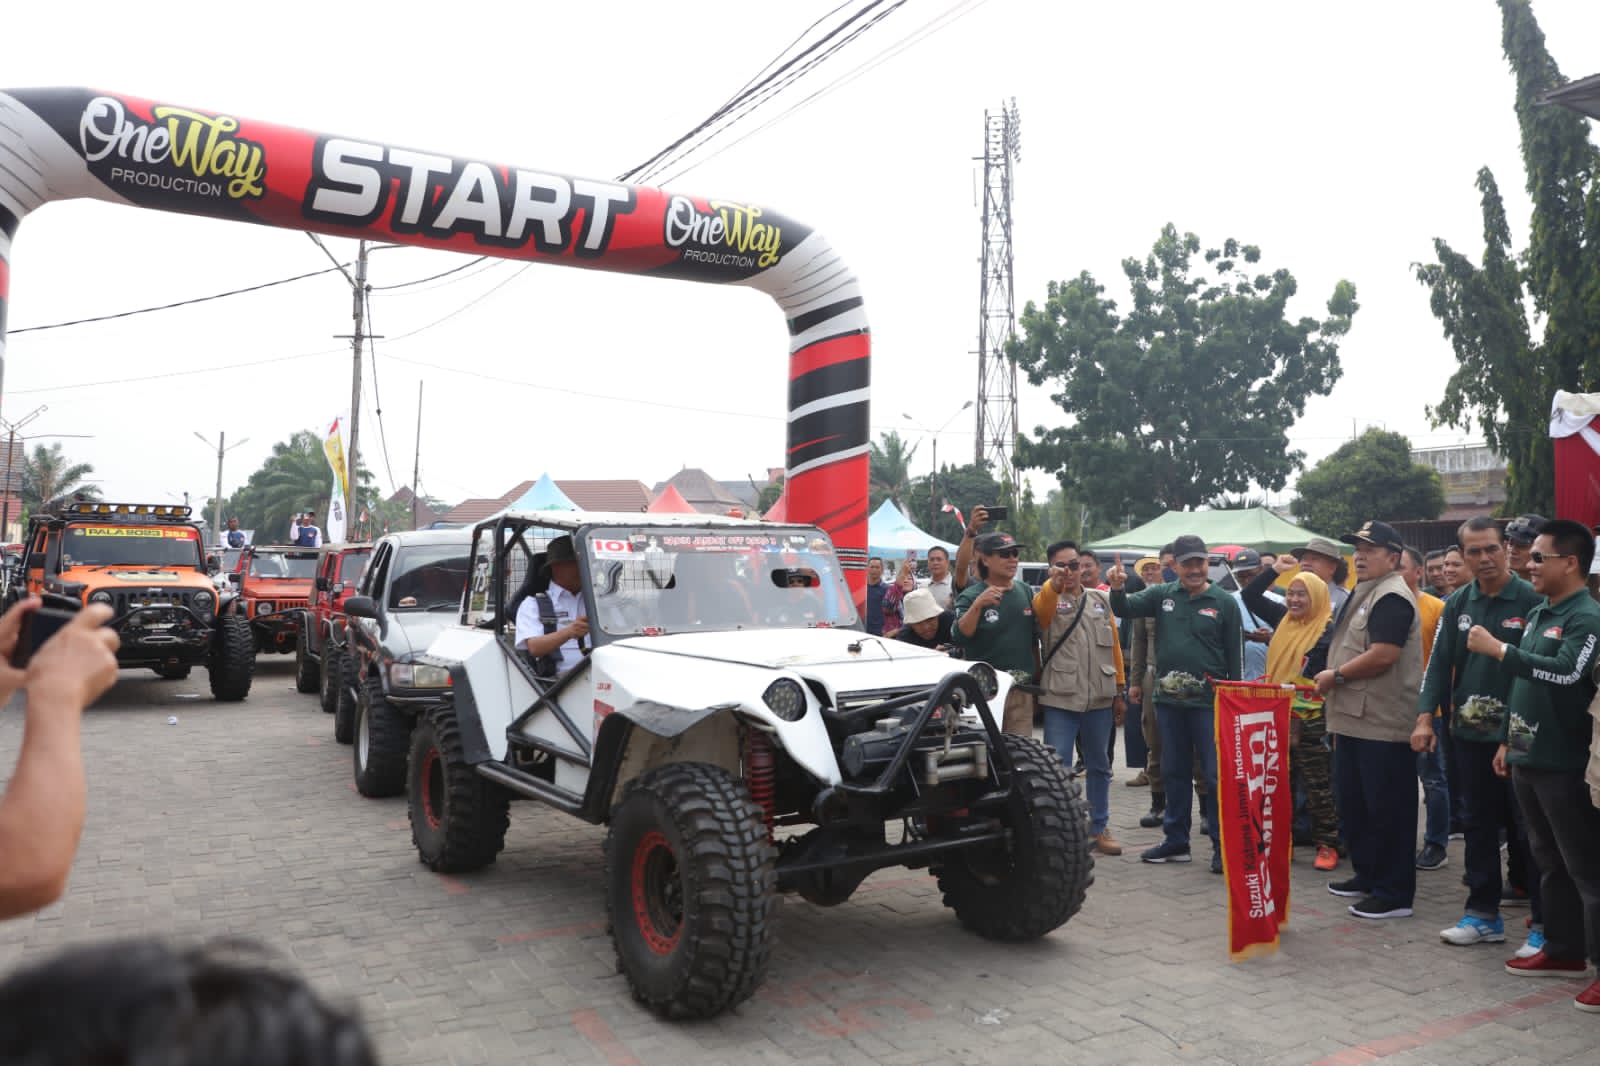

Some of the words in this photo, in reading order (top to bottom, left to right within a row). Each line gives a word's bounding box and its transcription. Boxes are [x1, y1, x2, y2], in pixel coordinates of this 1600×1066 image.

[111, 168, 222, 196] PRODUCTION
[312, 138, 629, 250] START
[684, 249, 755, 267] PRODUCTION
[88, 528, 125, 536] PALA
[1234, 715, 1244, 779] Indonesia
[1238, 783, 1250, 821] Jimny
[1243, 823, 1257, 871] Katana
[1245, 873, 1263, 918] Suzuki
